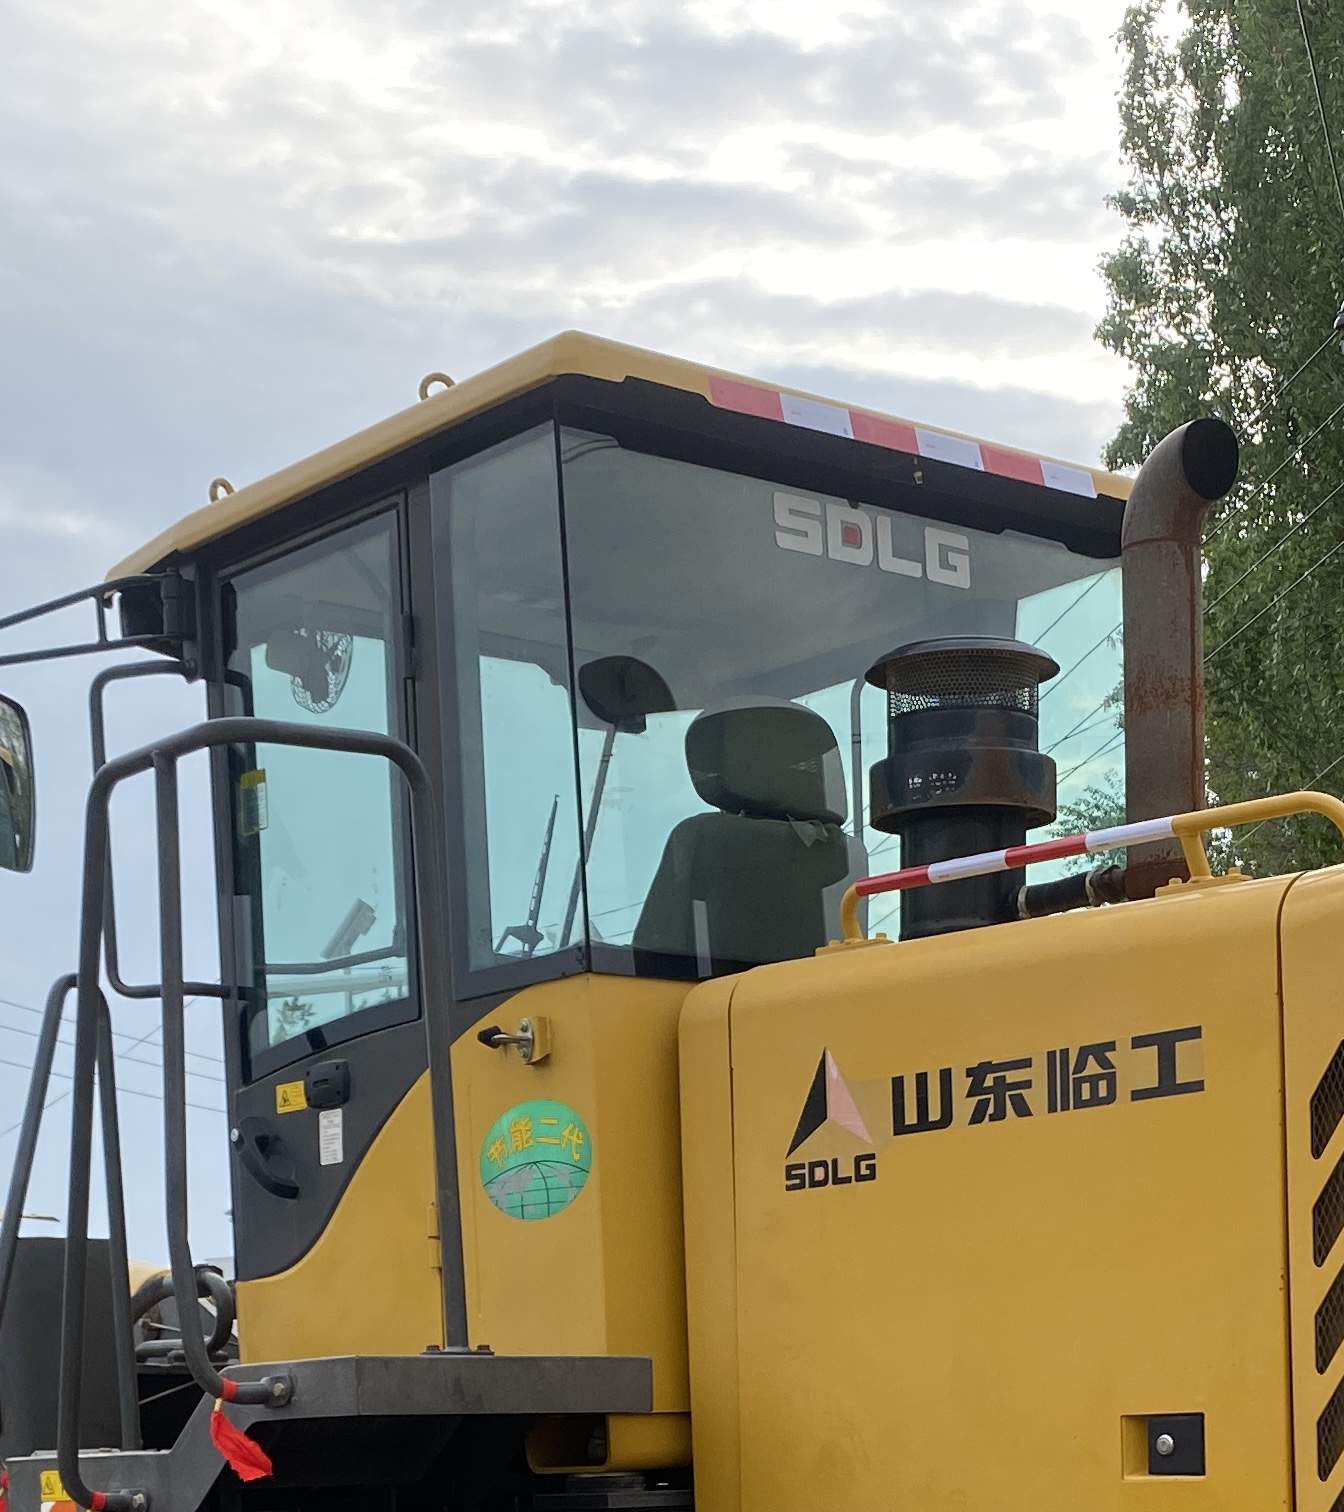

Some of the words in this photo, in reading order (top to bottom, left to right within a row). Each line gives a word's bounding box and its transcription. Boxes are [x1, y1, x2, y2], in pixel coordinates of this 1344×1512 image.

[773, 491, 971, 589] SDLG
[891, 1025, 1205, 1137] 山东临工
[785, 1153, 877, 1191] SDLG
